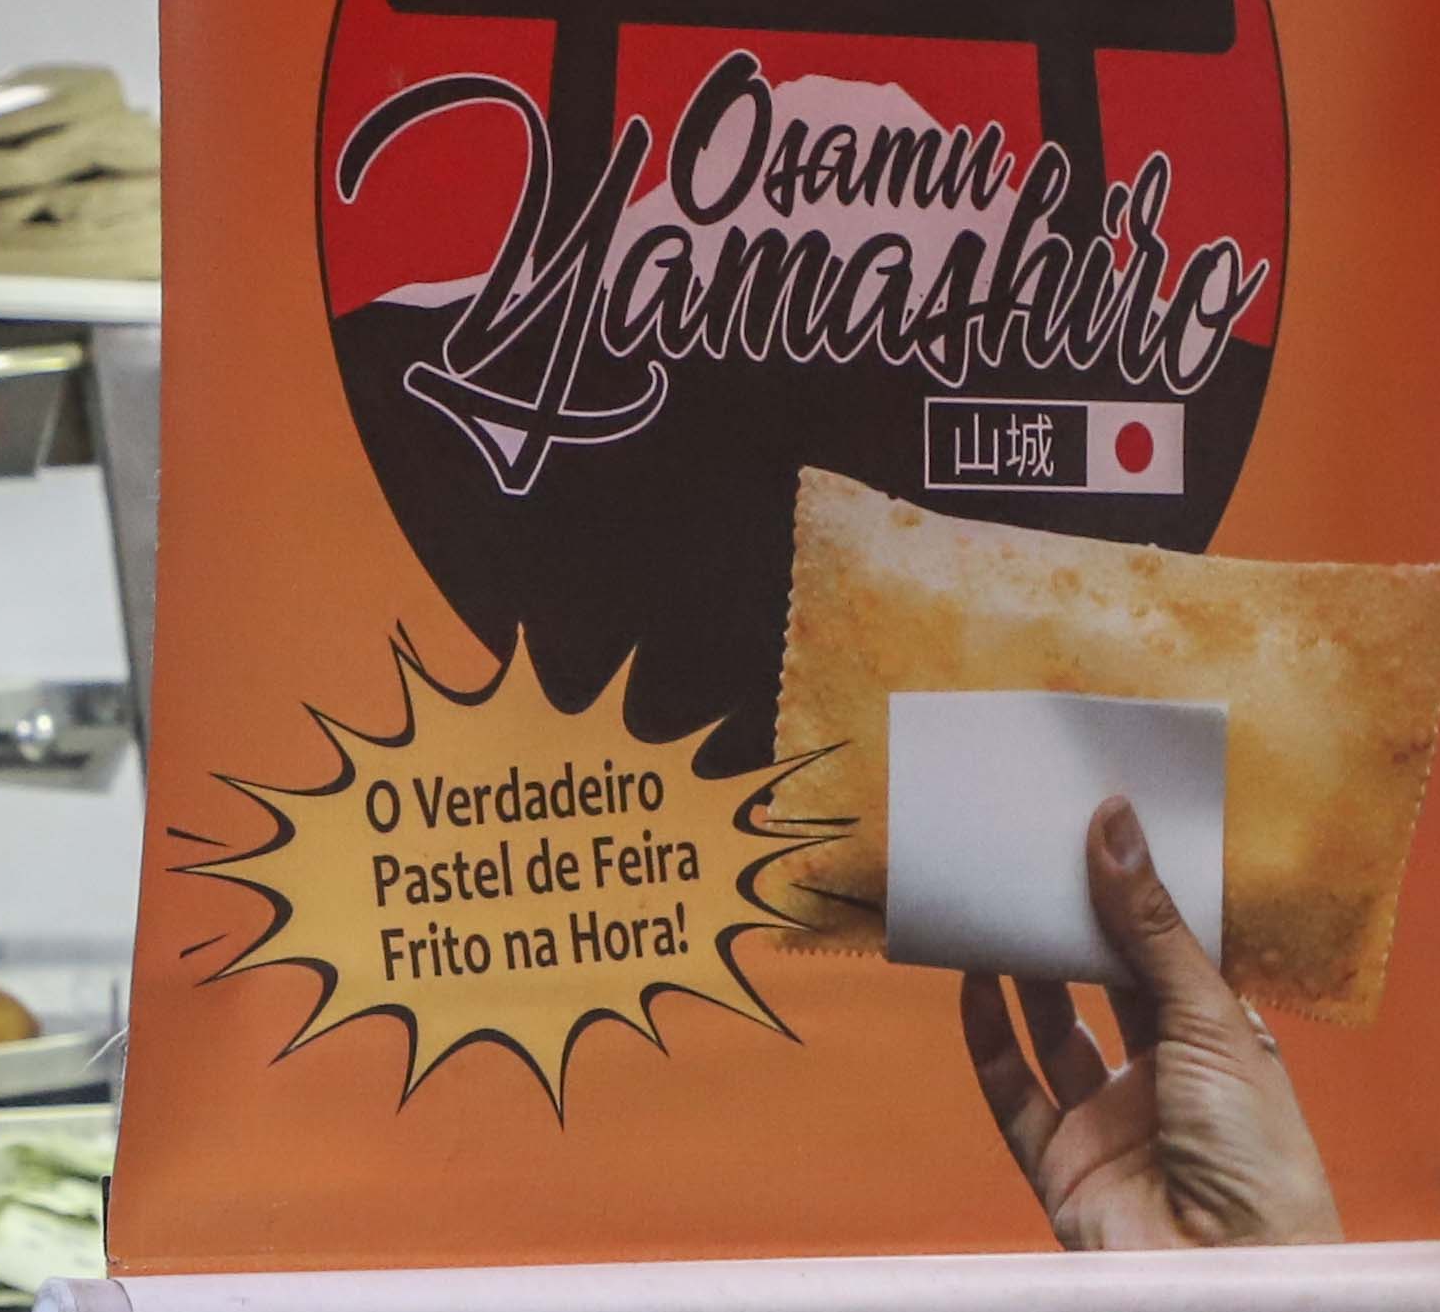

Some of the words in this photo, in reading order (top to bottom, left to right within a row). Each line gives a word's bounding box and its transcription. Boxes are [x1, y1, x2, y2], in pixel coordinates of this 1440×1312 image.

[667, 48, 1015, 225] Osamu
[336, 73, 1270, 495] Yamashiro
[953, 412, 1055, 478] 山城
[365, 779, 402, 834] O
[412, 759, 664, 829] Verdadeiro
[372, 840, 514, 907] Pastel
[526, 837, 580, 895] de
[592, 829, 700, 888] Feira
[380, 921, 491, 981] Frito
[503, 927, 559, 970] na
[569, 901, 689, 964] Hora!
